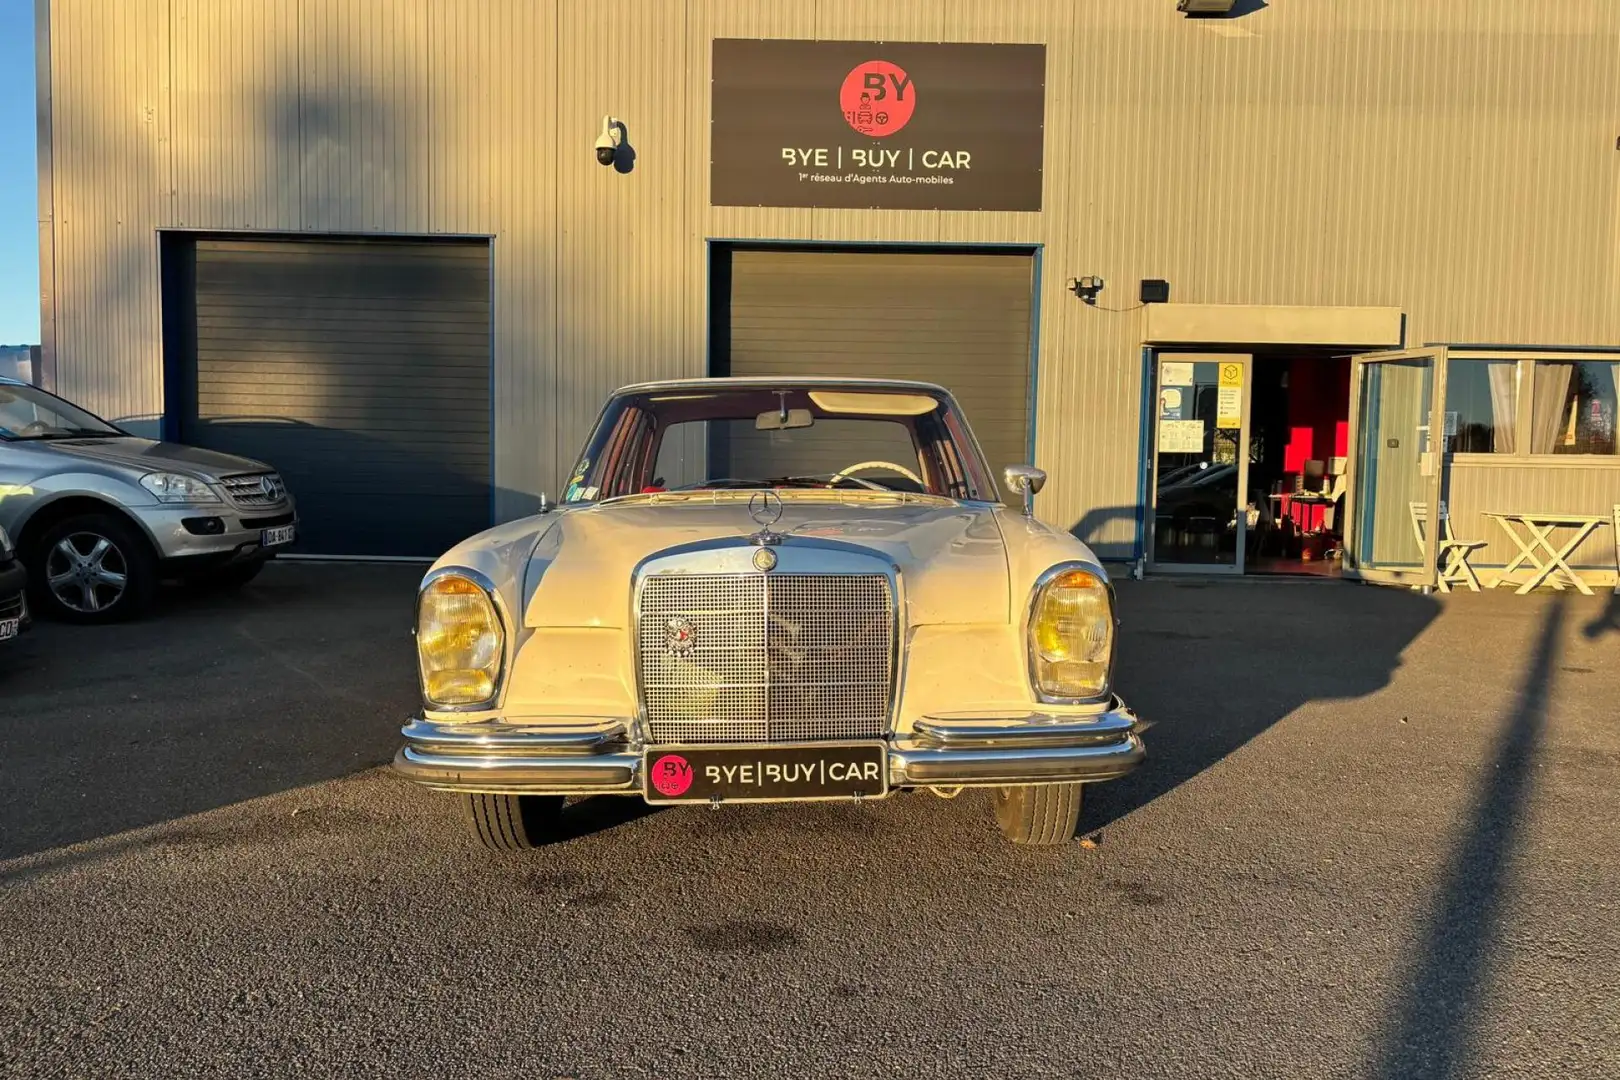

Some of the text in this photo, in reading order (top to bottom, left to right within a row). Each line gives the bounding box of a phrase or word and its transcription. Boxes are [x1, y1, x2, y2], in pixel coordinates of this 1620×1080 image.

[864, 73, 909, 101] BY
[782, 148, 971, 169] BYE BUY CAR
[810, 172, 842, 182] réseau
[844, 173, 887, 184] d'Agents
[889, 175, 954, 184] Auto-mobiles
[664, 761, 690, 777] BY
[705, 762, 879, 783] BYE BUY CAR
